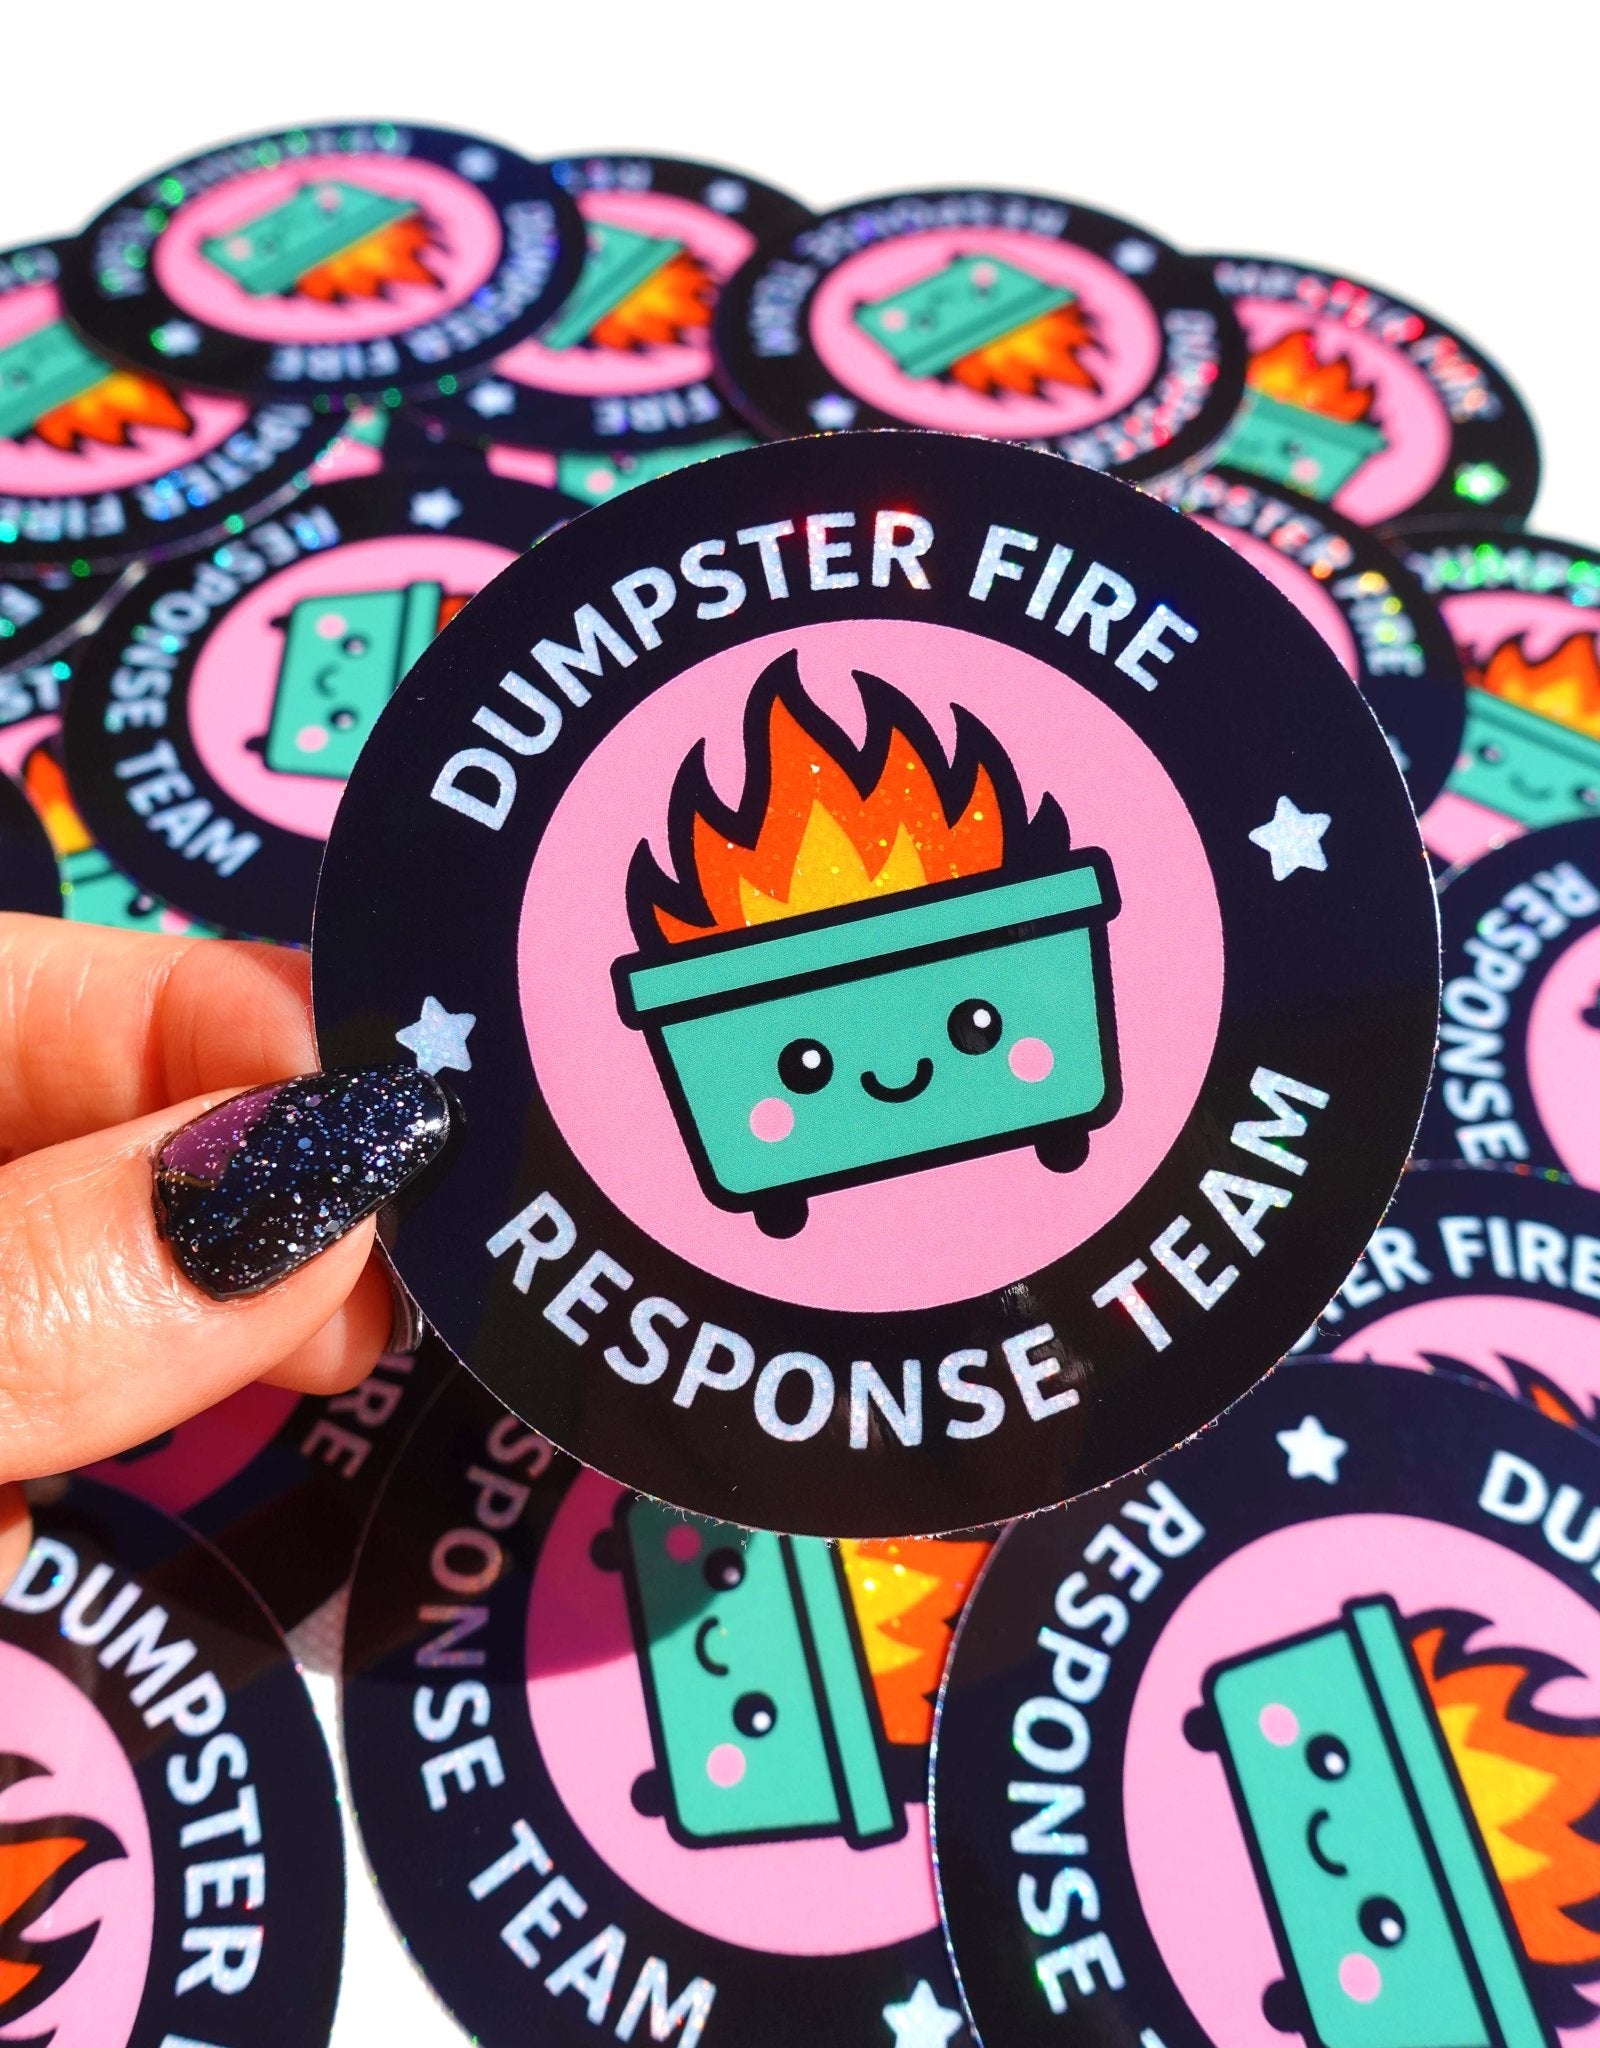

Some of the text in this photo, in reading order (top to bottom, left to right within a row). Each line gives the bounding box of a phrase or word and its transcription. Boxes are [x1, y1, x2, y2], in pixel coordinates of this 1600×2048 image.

[105, 507, 340, 878] RESPONSE TEAM
[430, 510, 1198, 831] DUMPSTER FIRE
[1438, 861, 1600, 1167] RESPONSE
[300, 1352, 417, 1479] IRE
[486, 1065, 1331, 1450] RESPONSE TEAM
[1438, 1215, 1600, 1300] FIRE
[3, 1537, 266, 1998] DUMPSTER
[413, 1413, 717, 2048] SPONSE TEAM
[1007, 1480, 1206, 2015] RESPONSE
